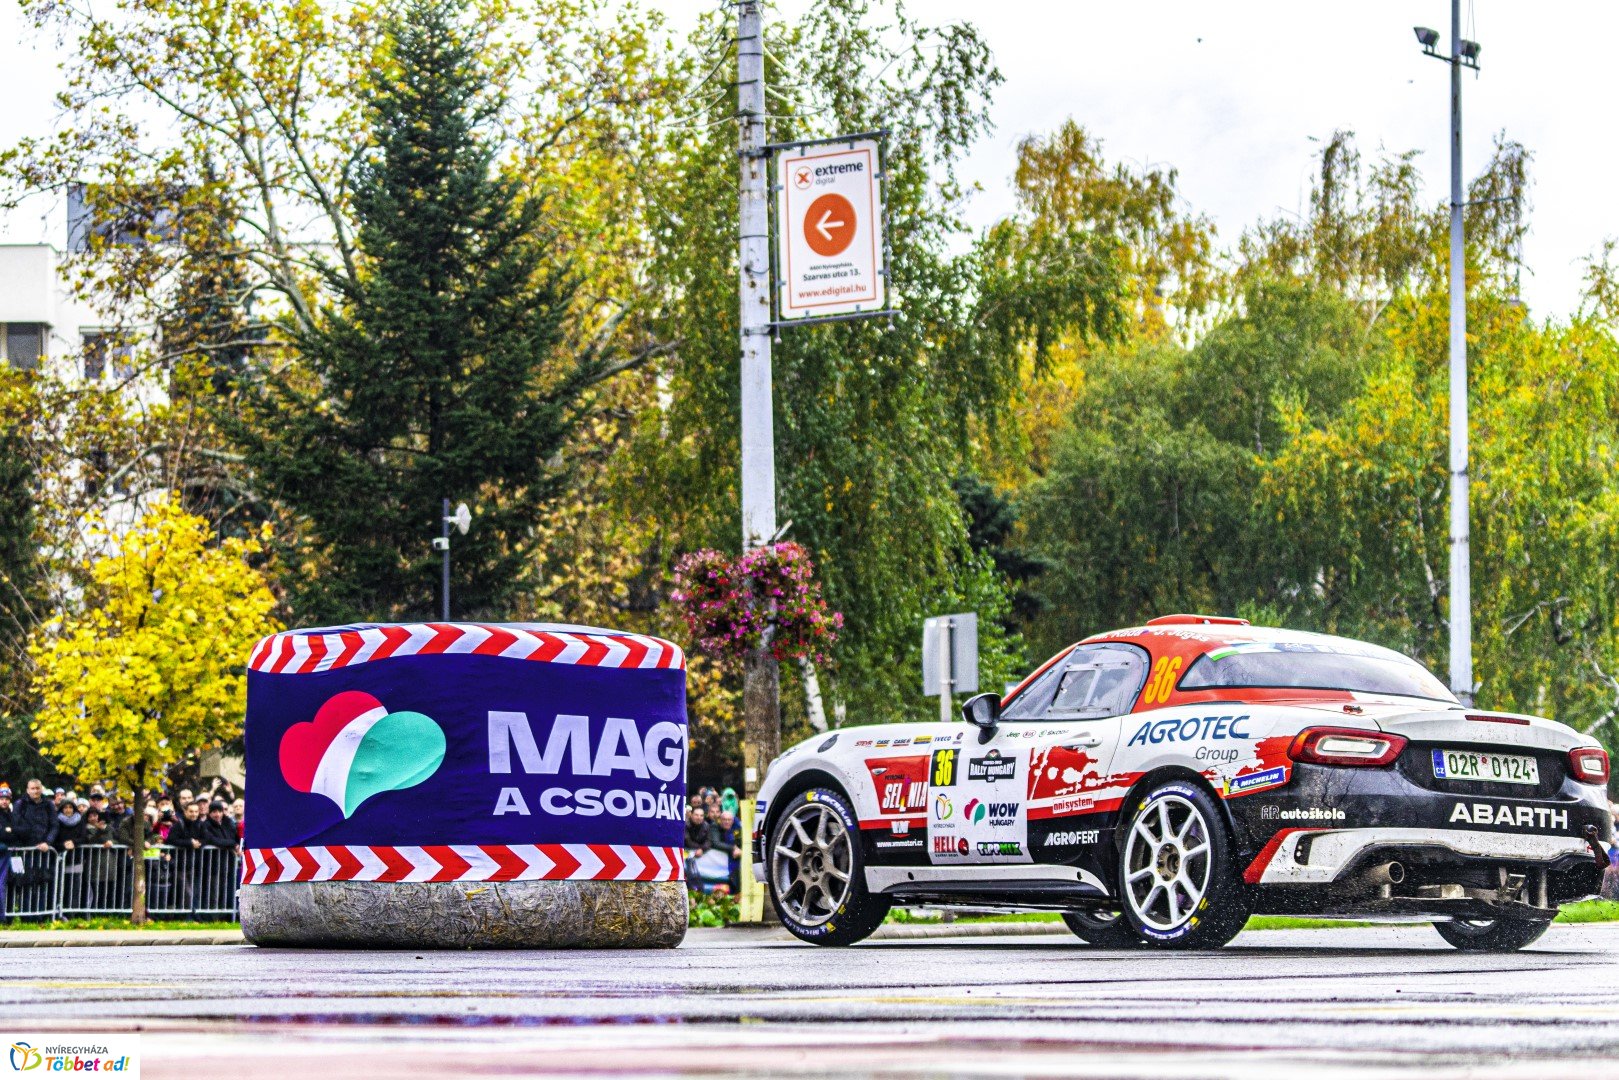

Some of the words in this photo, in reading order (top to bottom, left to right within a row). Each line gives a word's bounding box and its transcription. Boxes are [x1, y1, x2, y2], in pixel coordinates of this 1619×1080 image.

[815, 161, 864, 176] extreme
[815, 176, 836, 186] digital
[832, 270, 848, 278] utca
[849, 268, 861, 276] 13.
[799, 284, 867, 298] www.edigital.hu
[1145, 656, 1183, 704] 36
[1127, 715, 1251, 747] AGROTEC
[1195, 746, 1239, 763] Group
[935, 749, 954, 788] 36
[970, 763, 987, 776] RALLY
[987, 763, 1015, 776] HUNGARY
[1448, 753, 1480, 776] 02R
[1491, 756, 1531, 780] 0124
[1240, 773, 1280, 788] MICHELIN
[493, 788, 531, 816] A
[539, 783, 681, 820] CSODÁK
[989, 803, 1019, 817] WOW
[1280, 808, 1346, 820] autoškola
[1449, 802, 1568, 830] ABARTH
[934, 835, 957, 853] HELL
[1044, 830, 1100, 846] AGROFERT
